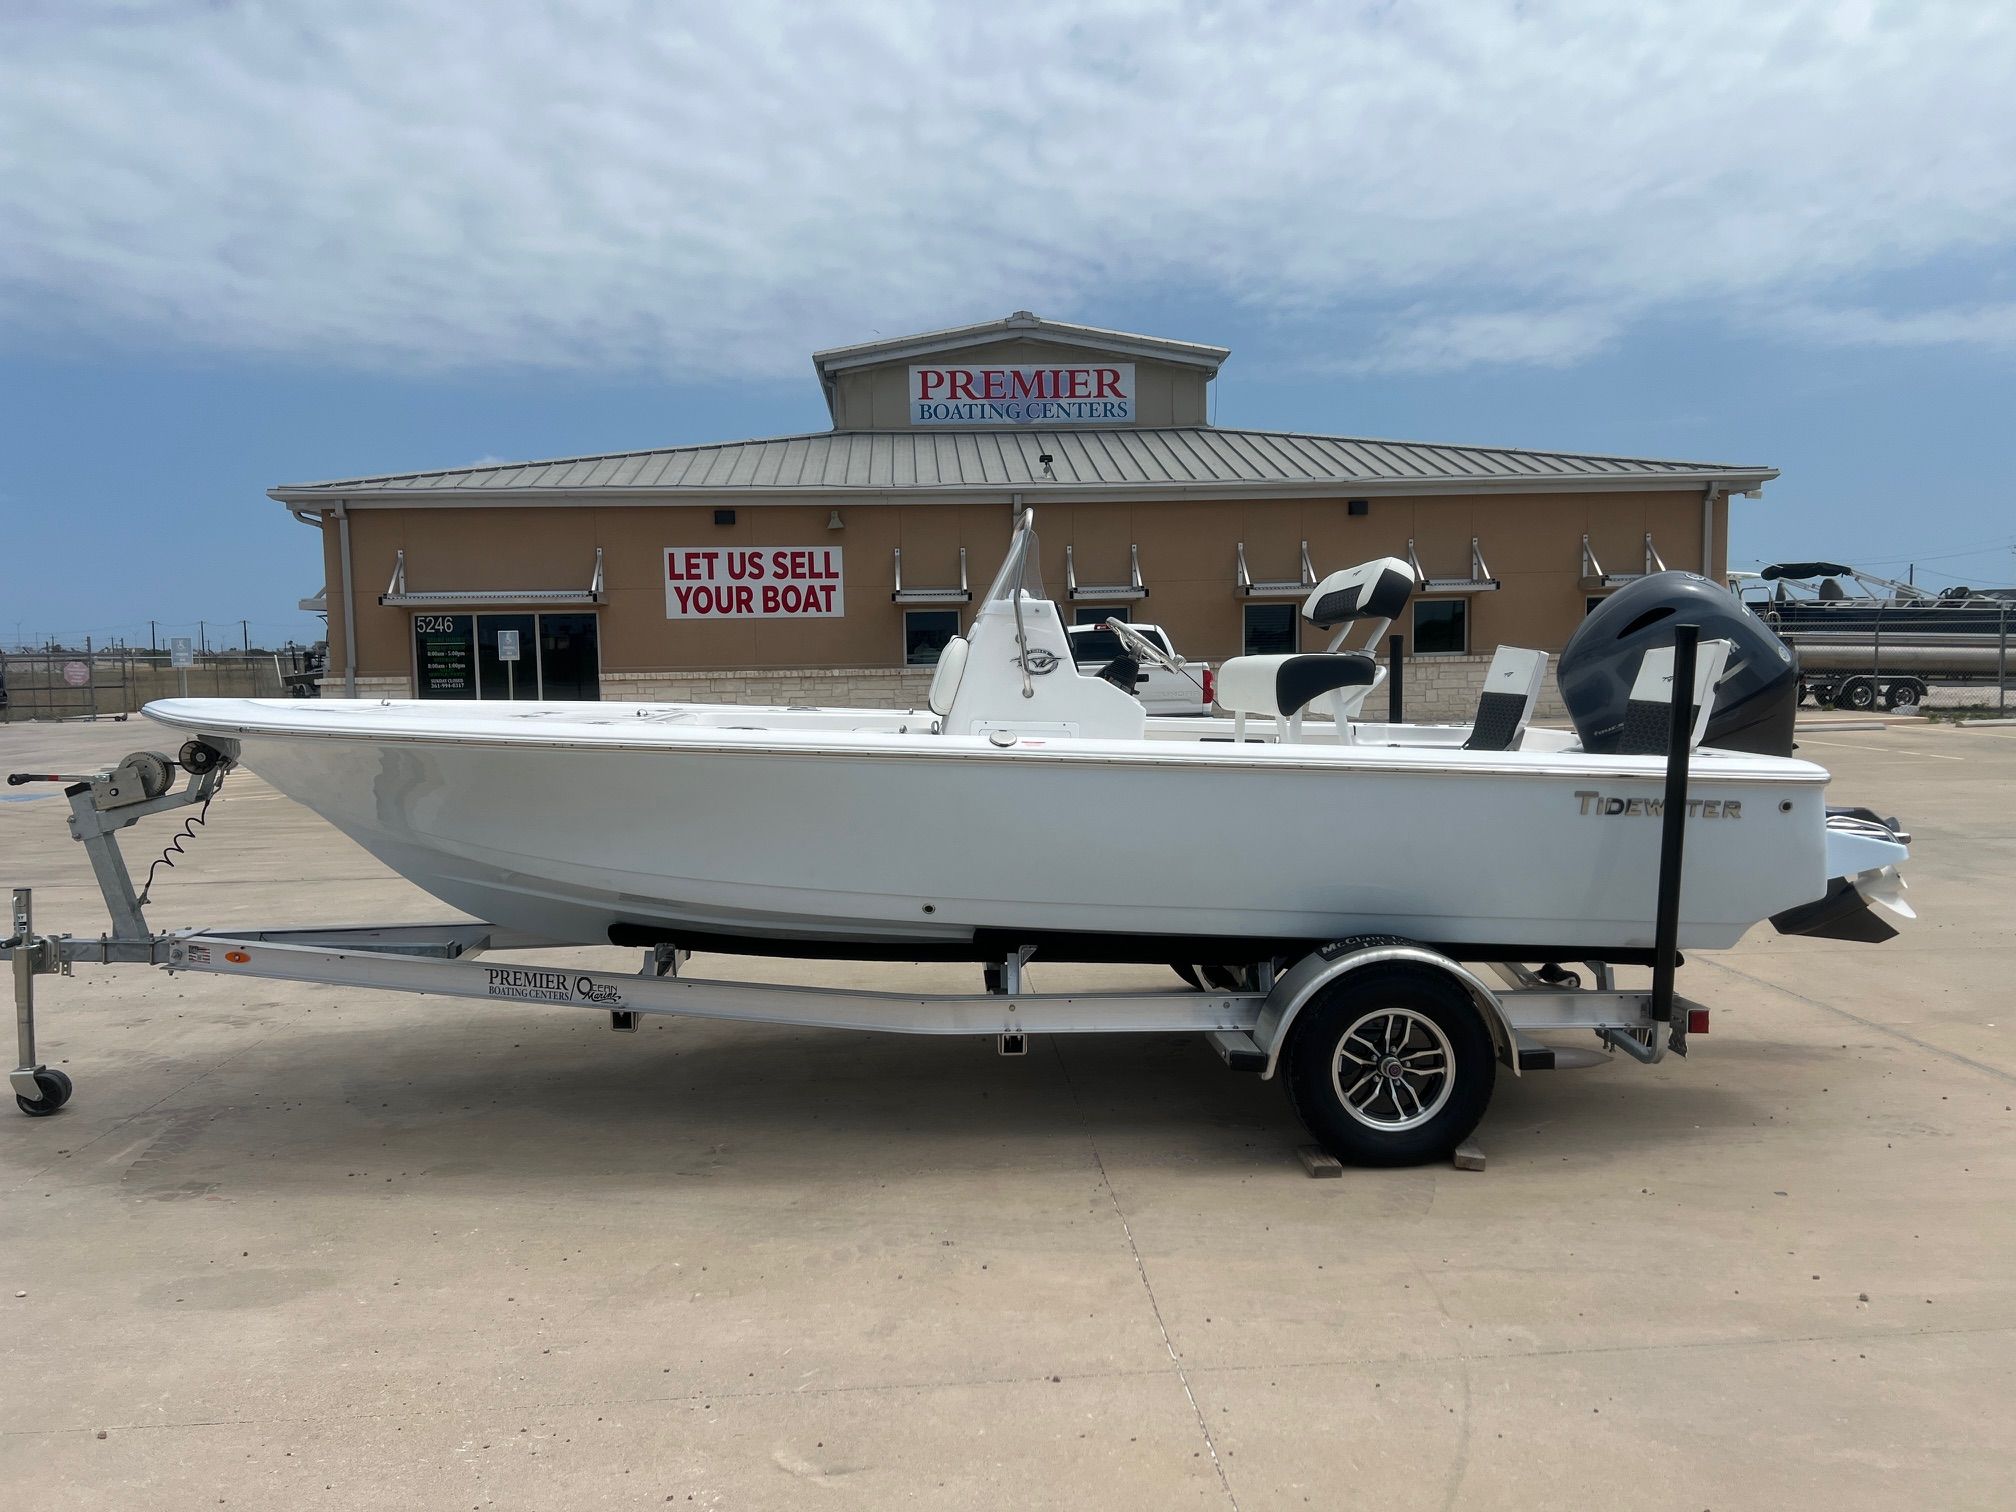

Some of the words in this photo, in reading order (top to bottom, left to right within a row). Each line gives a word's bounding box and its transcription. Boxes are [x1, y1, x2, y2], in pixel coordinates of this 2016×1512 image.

[917, 368, 1128, 401] PREMIER
[918, 402, 1021, 420] BOATING
[1025, 401, 1128, 419] CENTERS
[668, 552, 719, 581] LET
[727, 551, 765, 580] US
[772, 551, 840, 580] SELL
[674, 586, 754, 614] YOUR
[762, 585, 837, 614] BOAT
[417, 616, 454, 633] 5246
[1574, 790, 1742, 819] TIDEWTER
[485, 968, 569, 991] PREMIER
[488, 986, 529, 998] BOATING
[529, 988, 570, 1001] CENTERS
